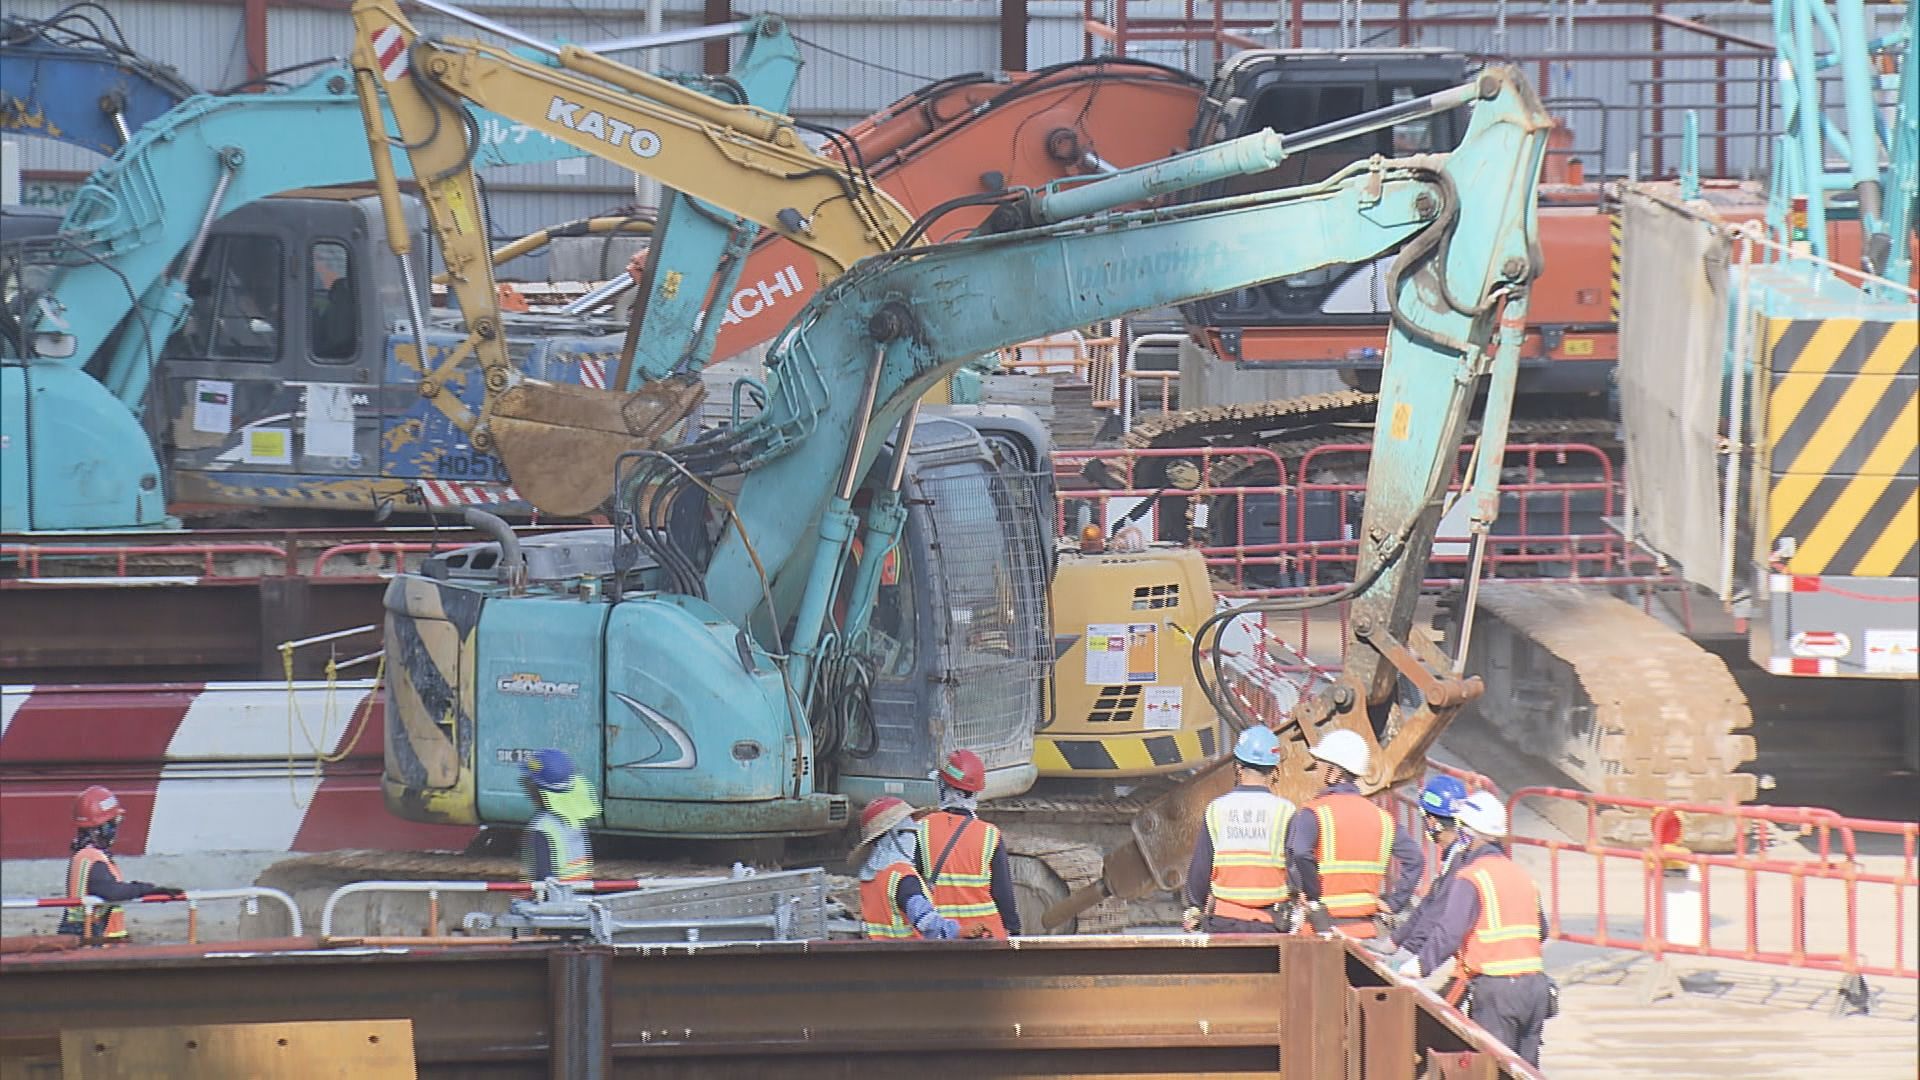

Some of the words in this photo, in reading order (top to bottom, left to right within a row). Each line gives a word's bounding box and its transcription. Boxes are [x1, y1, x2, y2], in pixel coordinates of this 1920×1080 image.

[546, 96, 662, 158] KATO
[694, 265, 804, 333] ACHI
[437, 453, 508, 479] HD51
[1226, 825, 1267, 841] SIGNALMAN
